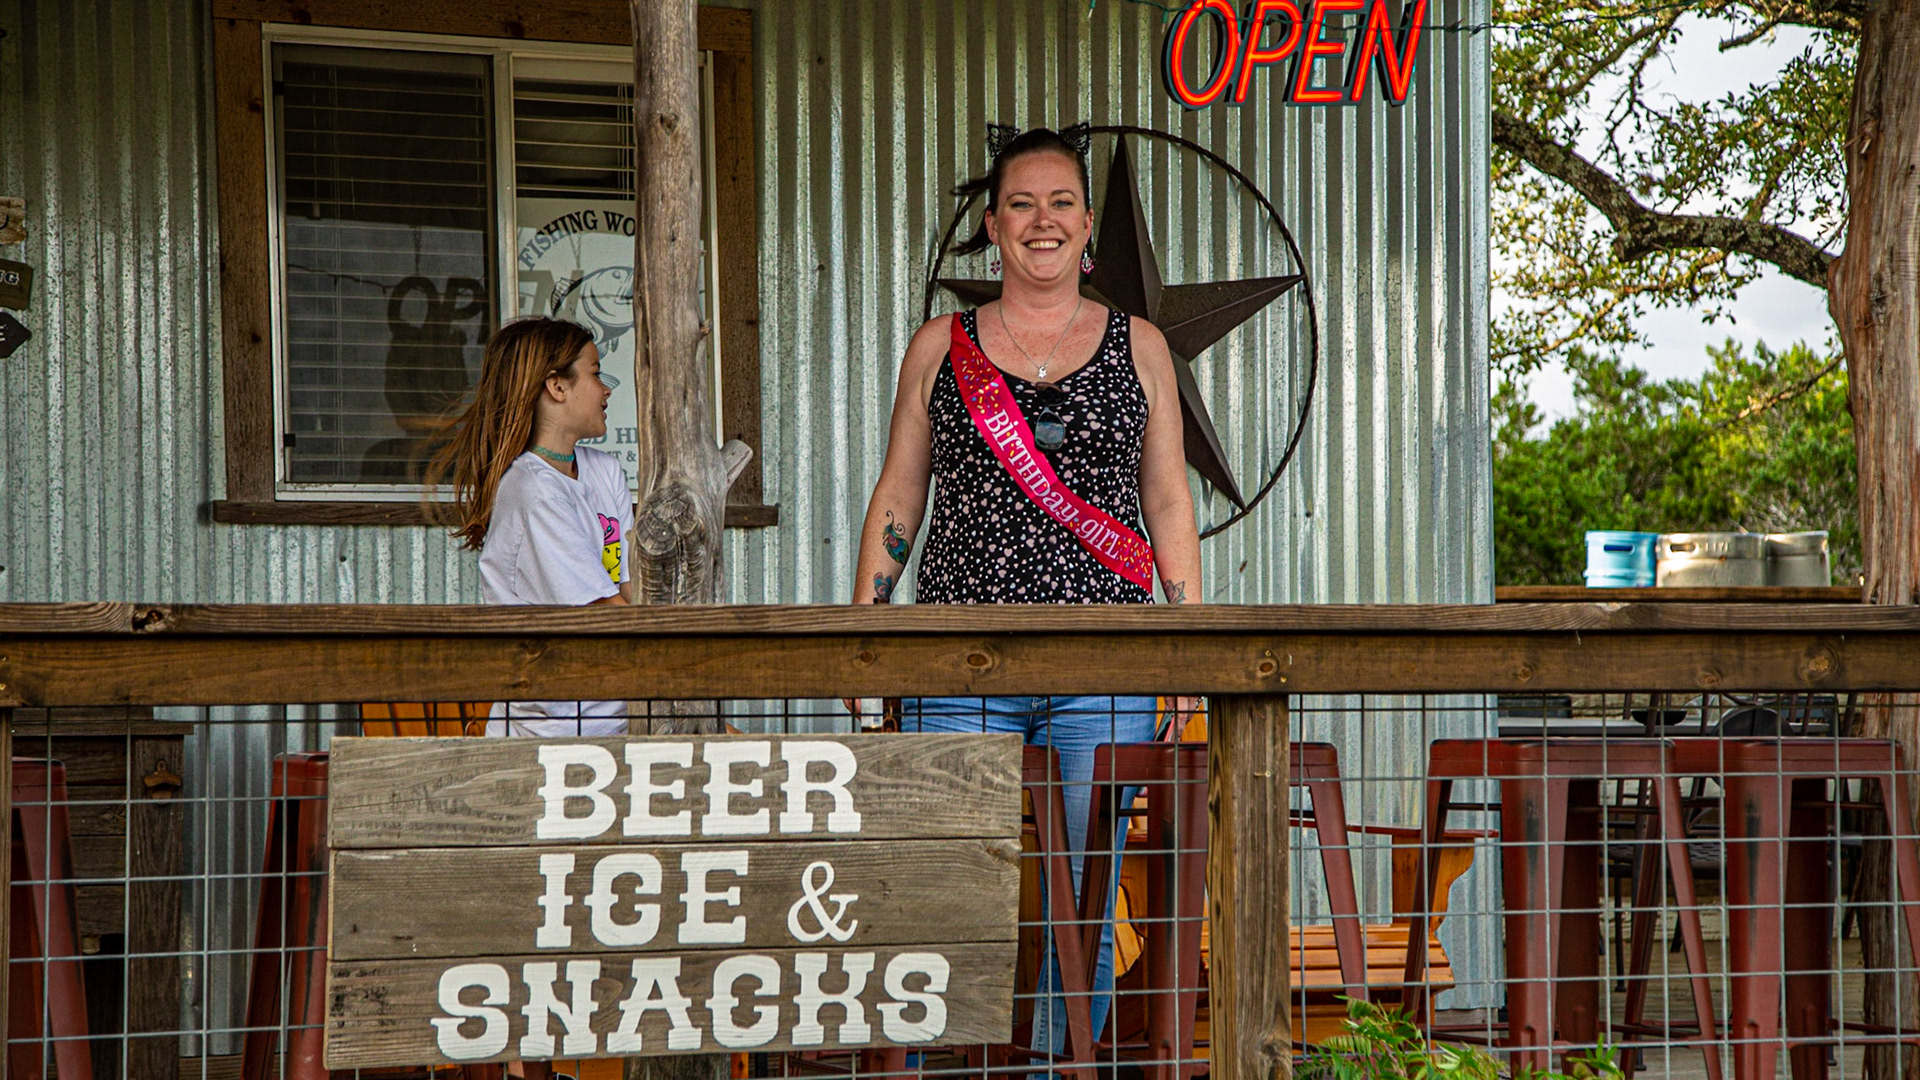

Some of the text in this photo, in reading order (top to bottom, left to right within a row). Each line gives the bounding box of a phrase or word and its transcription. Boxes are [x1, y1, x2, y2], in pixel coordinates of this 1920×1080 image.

[1169, 0, 1427, 106] OPEN
[518, 209, 598, 271] FISHING
[536, 740, 862, 840] BEER
[535, 850, 859, 949] ICE &
[430, 952, 952, 1060] SNACKS
